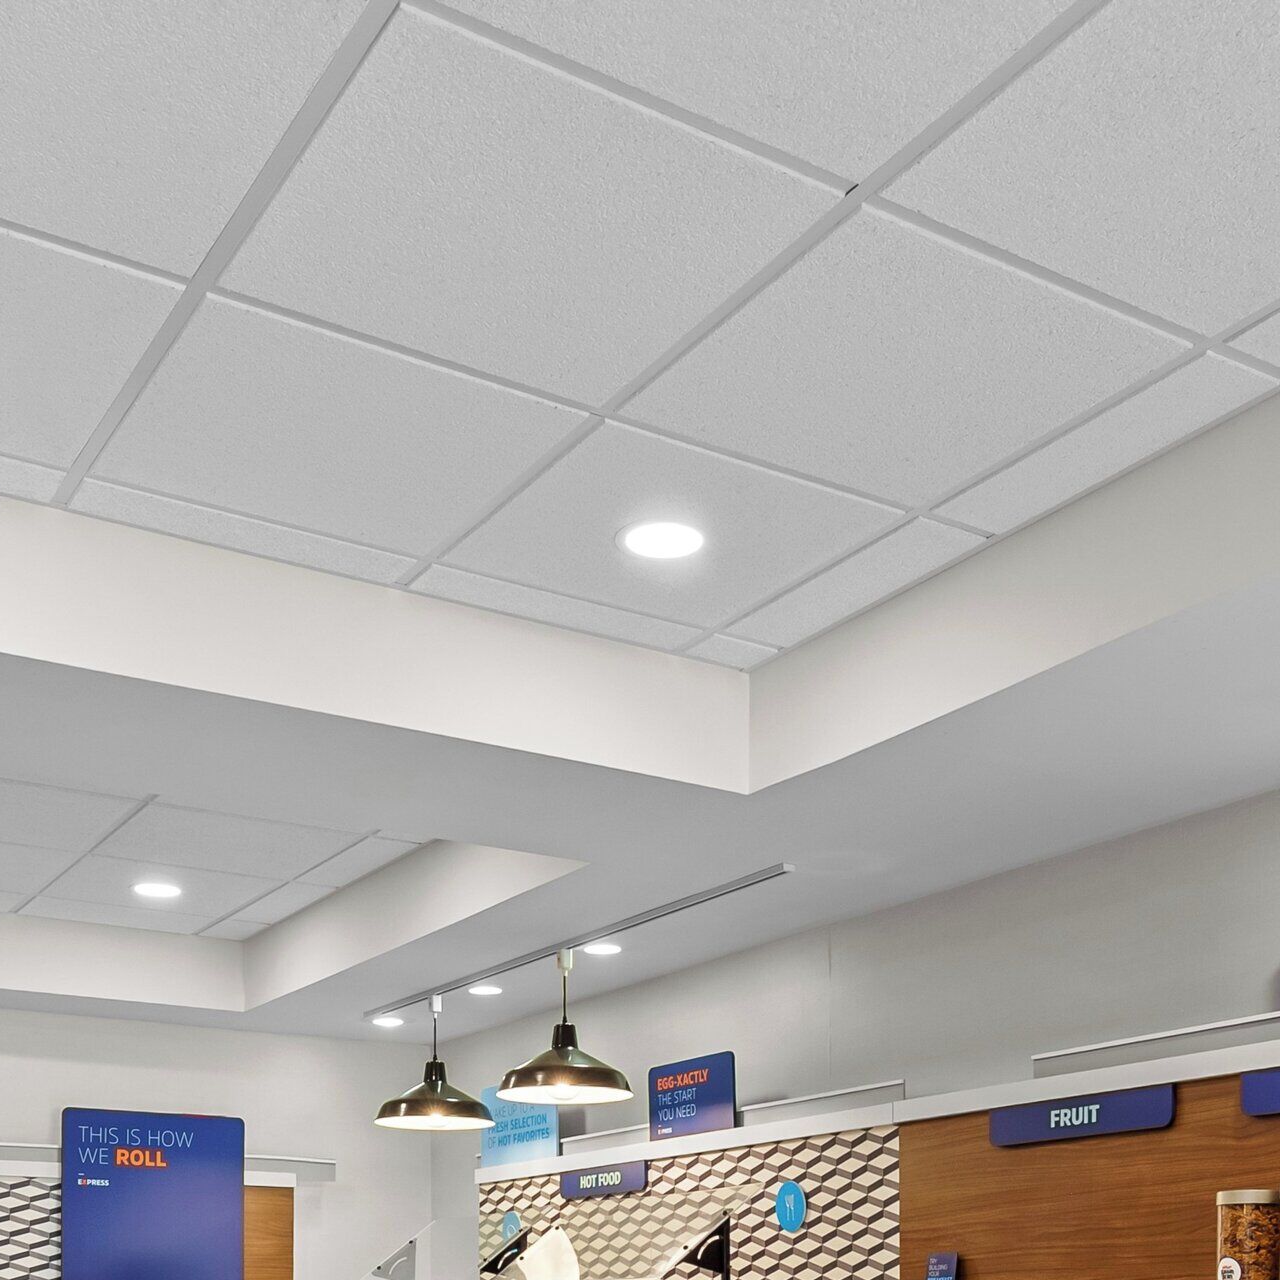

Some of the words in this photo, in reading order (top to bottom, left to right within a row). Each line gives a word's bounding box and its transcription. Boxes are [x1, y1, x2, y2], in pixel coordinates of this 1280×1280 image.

[657, 1069, 709, 1091] EGG-XACTLY
[658, 1092, 672, 1106] THE
[673, 1088, 697, 1103] START
[510, 1113, 547, 1130] SELECTION
[658, 1108, 674, 1121] YOU
[676, 1104, 697, 1118] NEED
[1050, 1104, 1100, 1128] FRUIT
[78, 1126, 119, 1145] THIS
[126, 1128, 141, 1146] IS
[148, 1130, 194, 1148] HOW
[497, 1134, 511, 1147] HOT
[513, 1127, 550, 1145] FAVORITES
[78, 1147, 109, 1165] WE
[115, 1148, 167, 1167] ROLL
[77, 1178, 110, 1187] EXPRESS
[580, 1174, 597, 1189] HOT
[598, 1171, 621, 1187] FOOD
